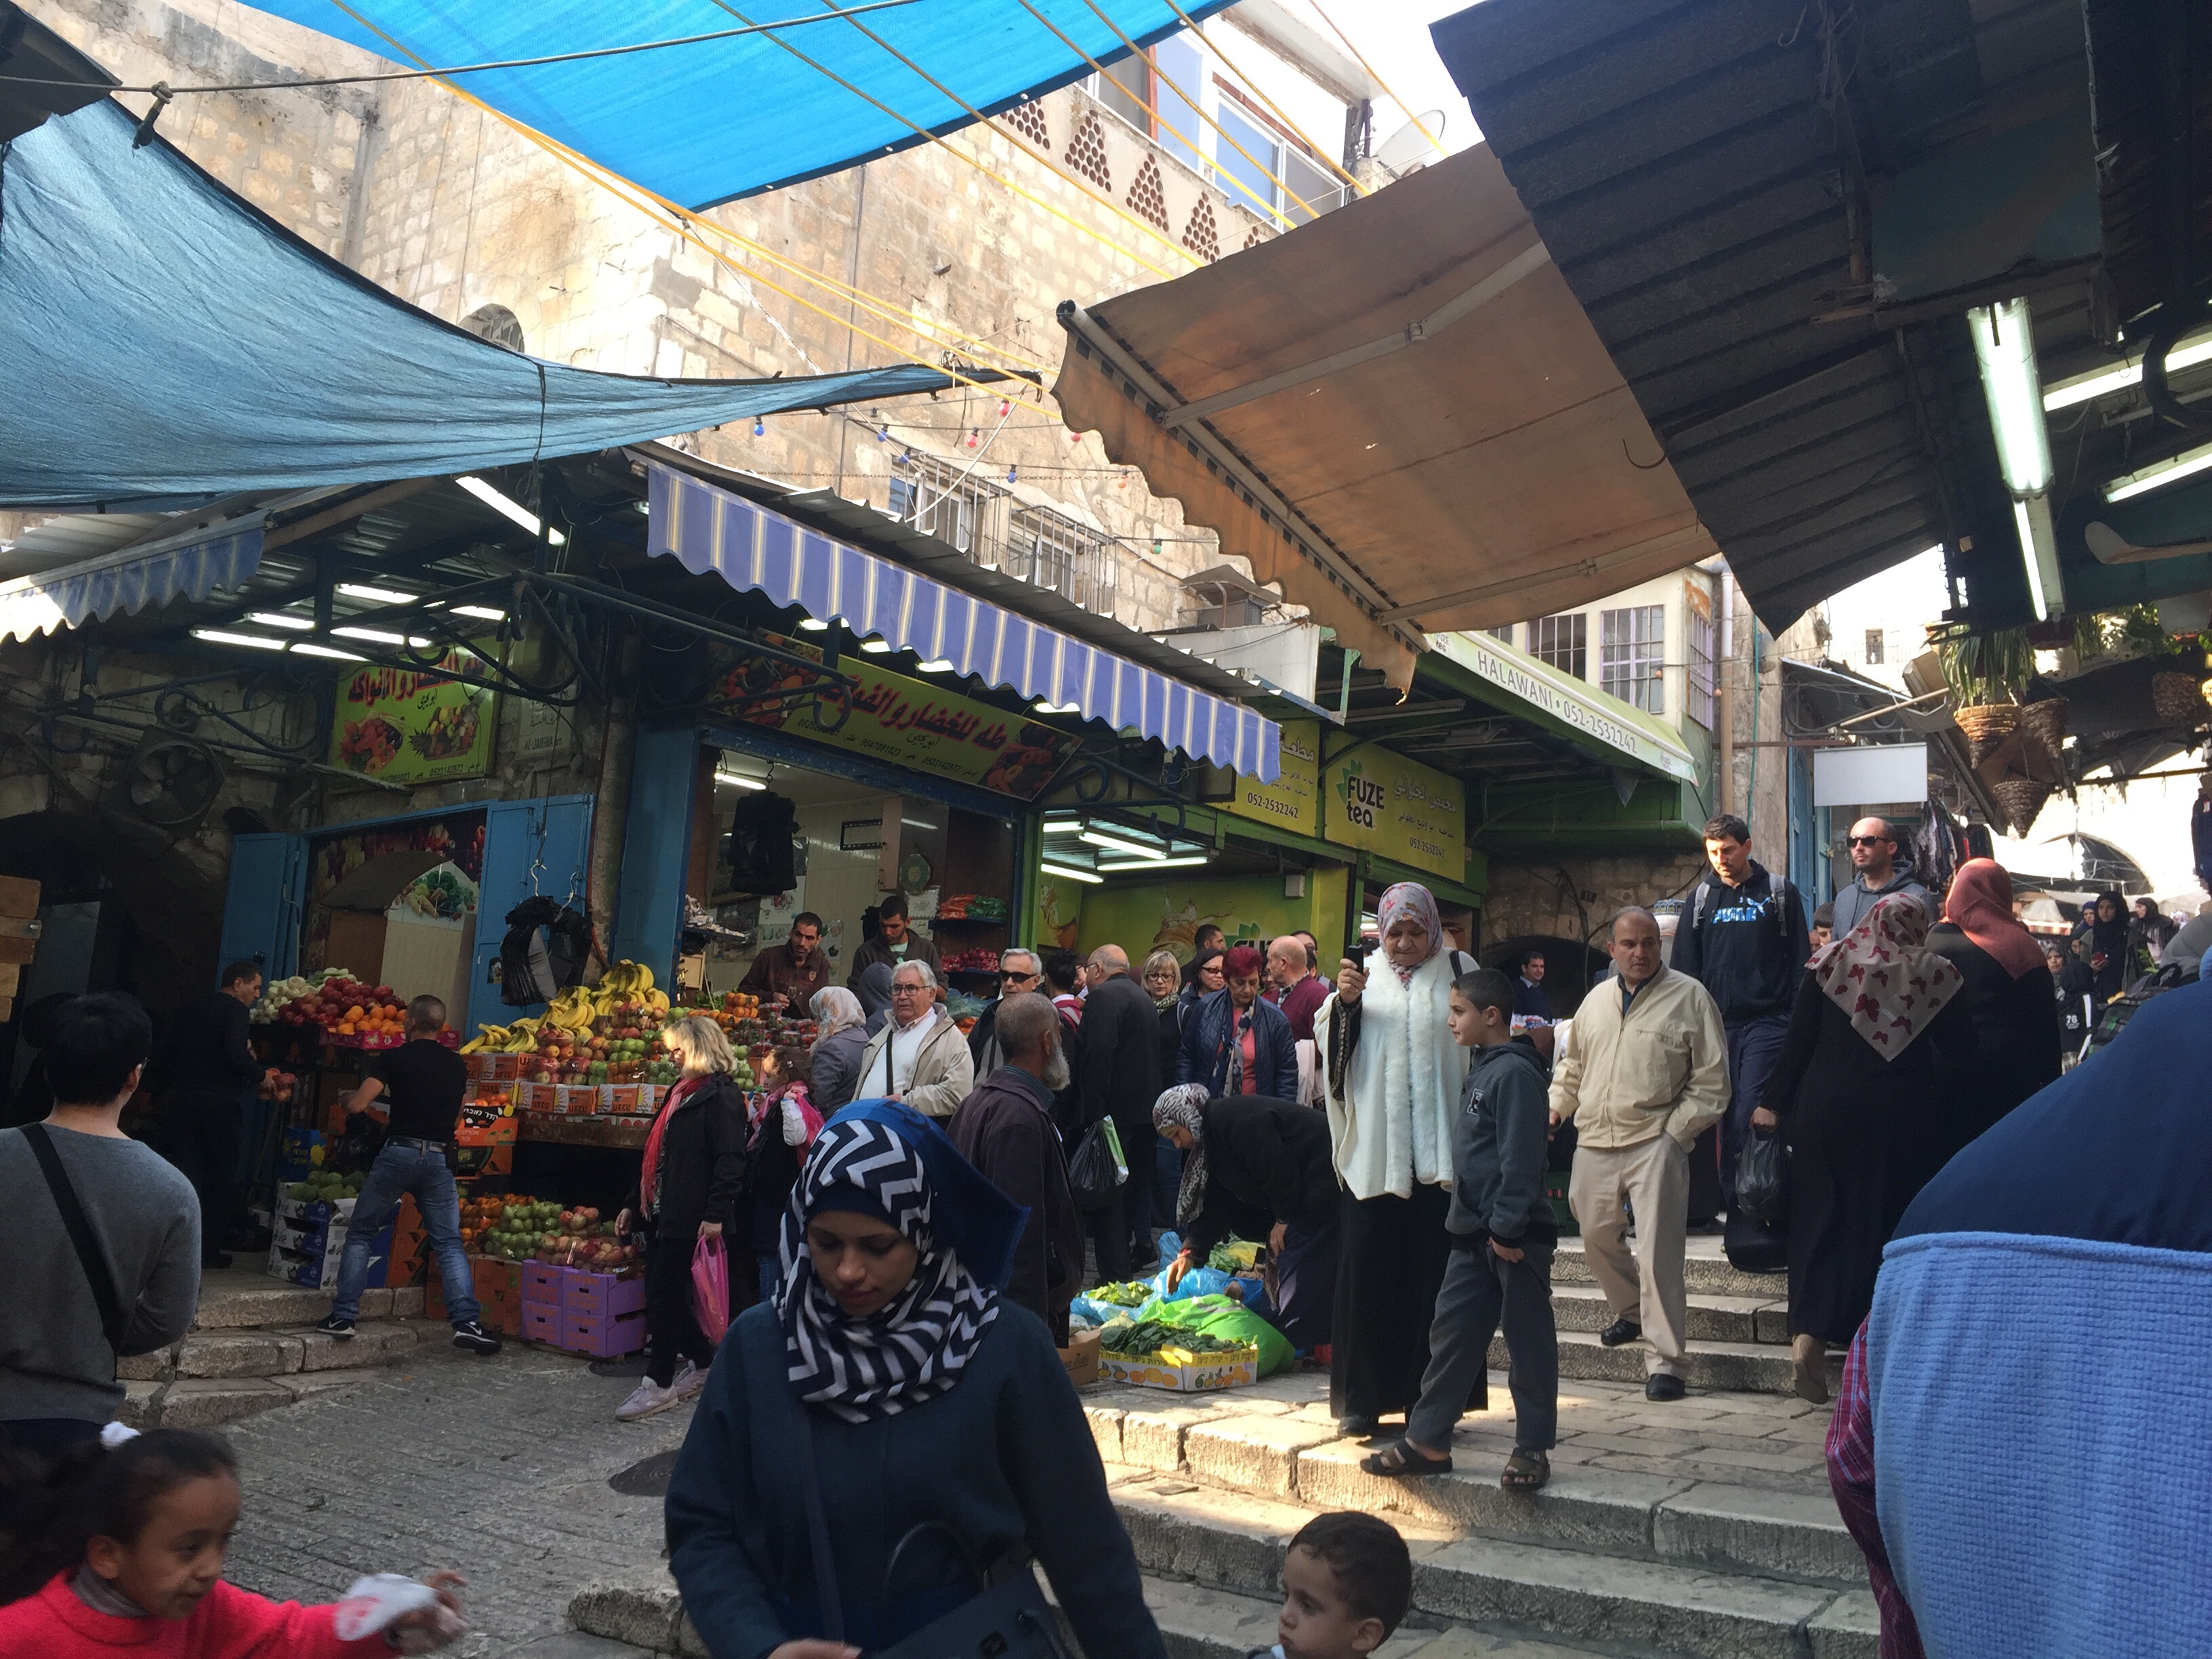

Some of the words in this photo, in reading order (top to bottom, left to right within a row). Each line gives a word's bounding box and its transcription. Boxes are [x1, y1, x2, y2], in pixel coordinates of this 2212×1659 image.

[1477, 650, 1553, 710] HALAWANI
[1563, 700, 1637, 754] 052-2532242
[1347, 776, 1385, 810] FUZE
[1247, 792, 1298, 819] 052-2532242
[1346, 800, 1373, 828] tea
[1410, 836, 1446, 858] 052-2532242
[1713, 907, 1757, 924] PUMA
[464, 1108, 483, 1116] מובח
[485, 1111, 498, 1120] הדר
